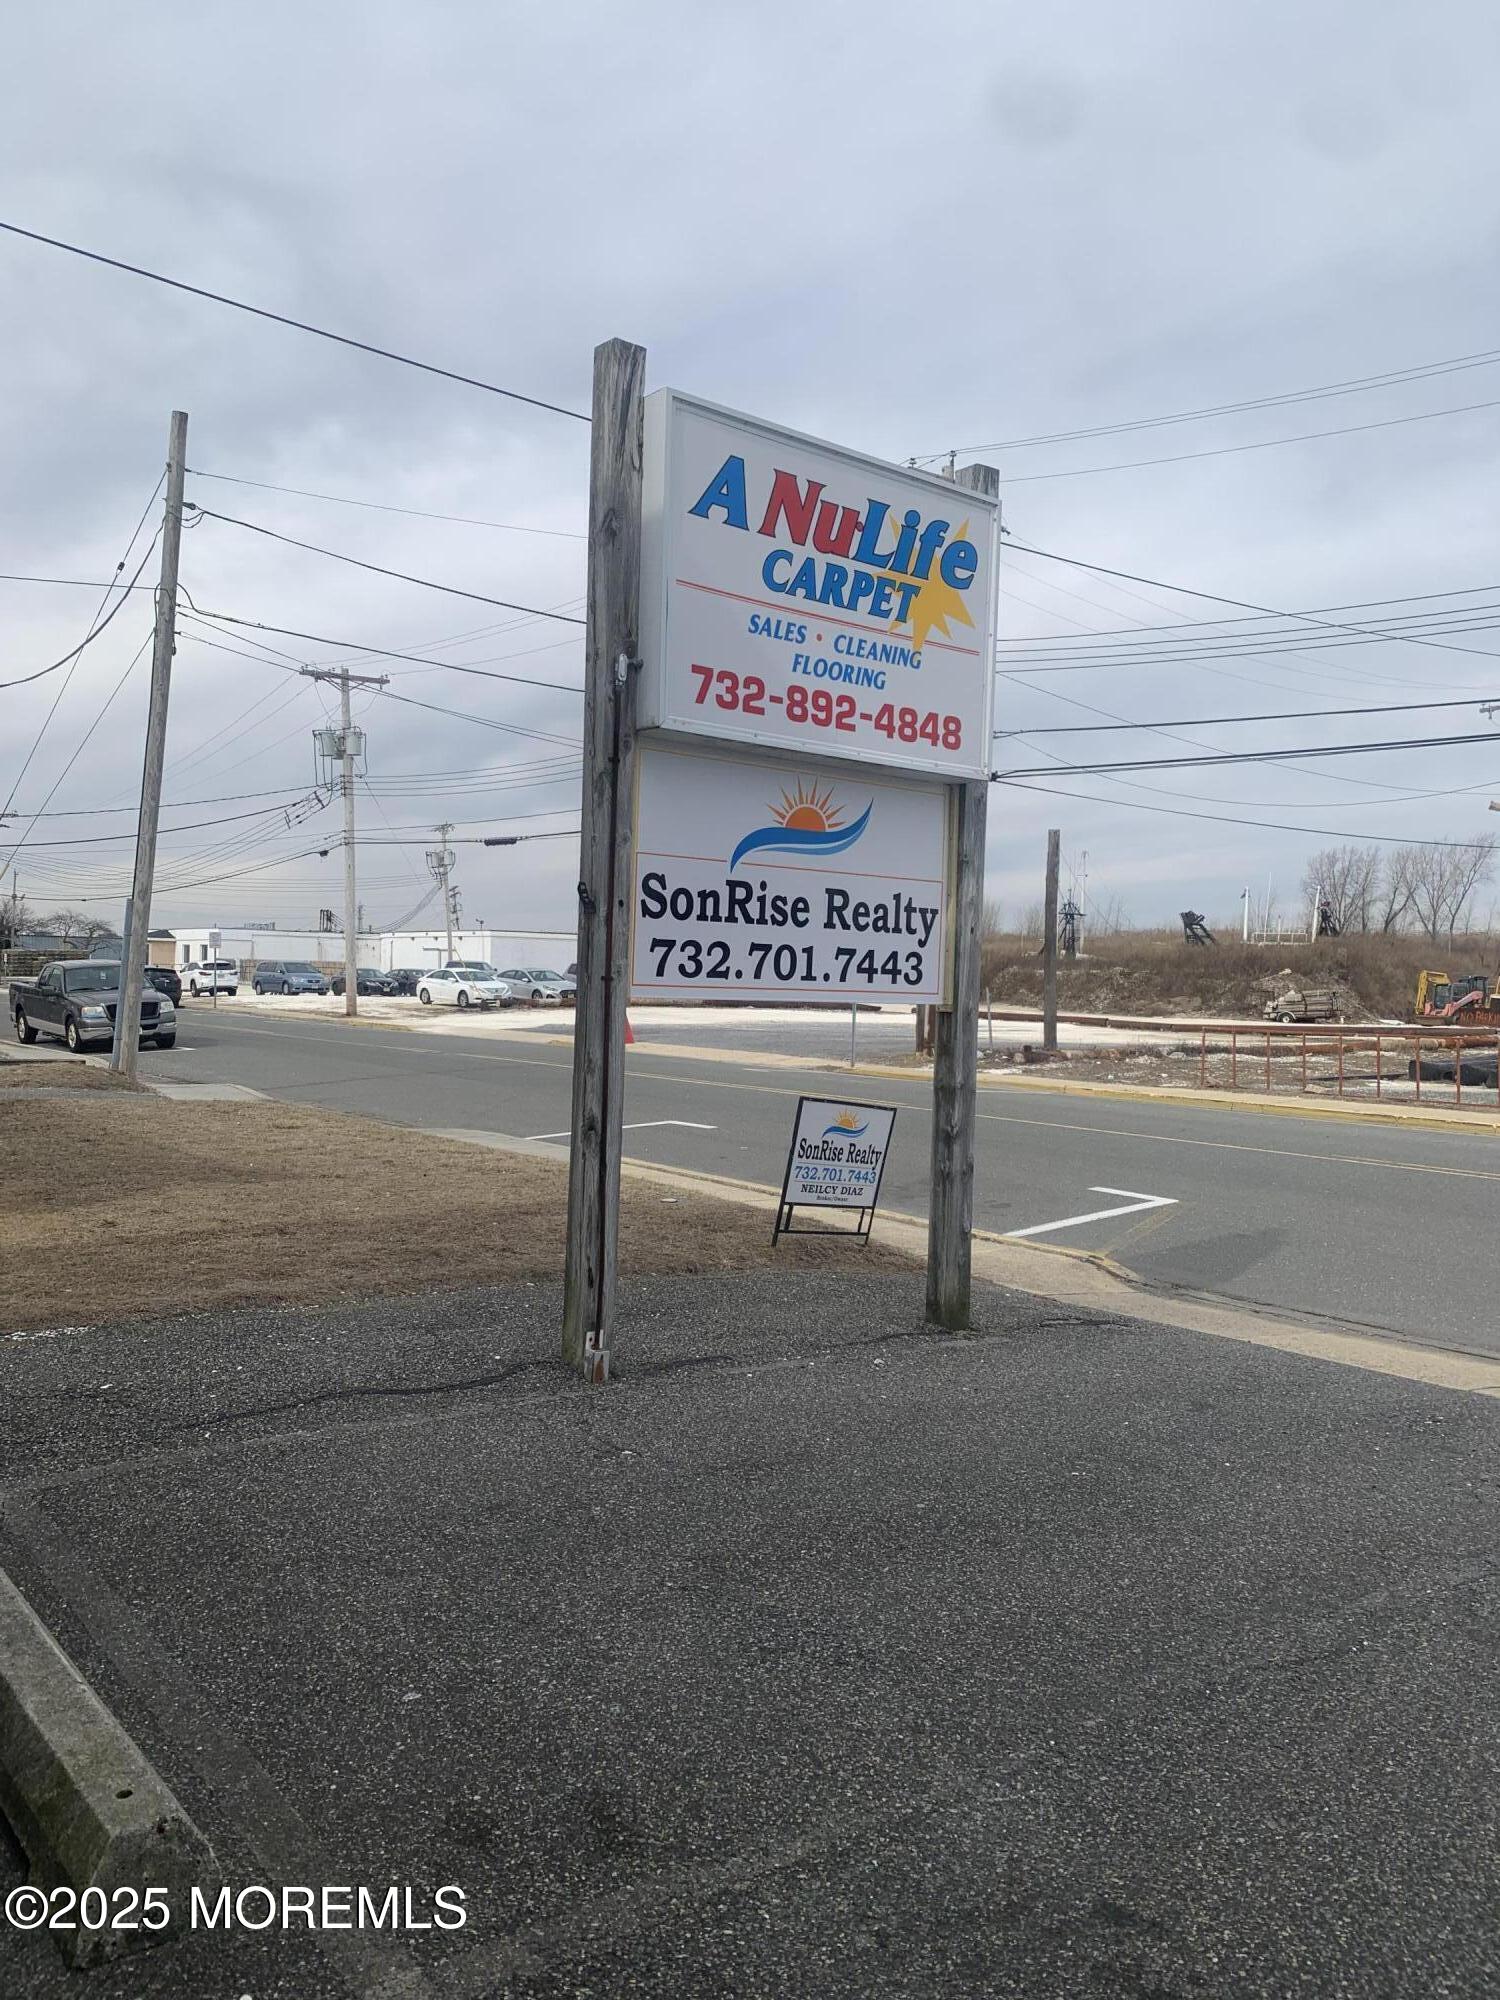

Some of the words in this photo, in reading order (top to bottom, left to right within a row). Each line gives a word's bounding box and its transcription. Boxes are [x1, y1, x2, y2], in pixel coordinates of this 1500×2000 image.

[688, 454, 749, 531] A
[762, 549, 921, 624] CARPET
[748, 614, 807, 644] SALES
[833, 634, 922, 669] CLEANING
[792, 653, 886, 690] FLOORING
[691, 664, 962, 750] 732-892-4848
[640, 872, 810, 928] SonRise
[823, 887, 939, 948] Realty
[649, 937, 923, 986] 732.701.7443
[794, 1166, 876, 1184] 732.701.7443
[798, 1138, 843, 1162] SonRise
[846, 1143, 882, 1170] Realty
[801, 1184, 838, 1195] NEILCY
[841, 1186, 863, 1196] DIAZ
